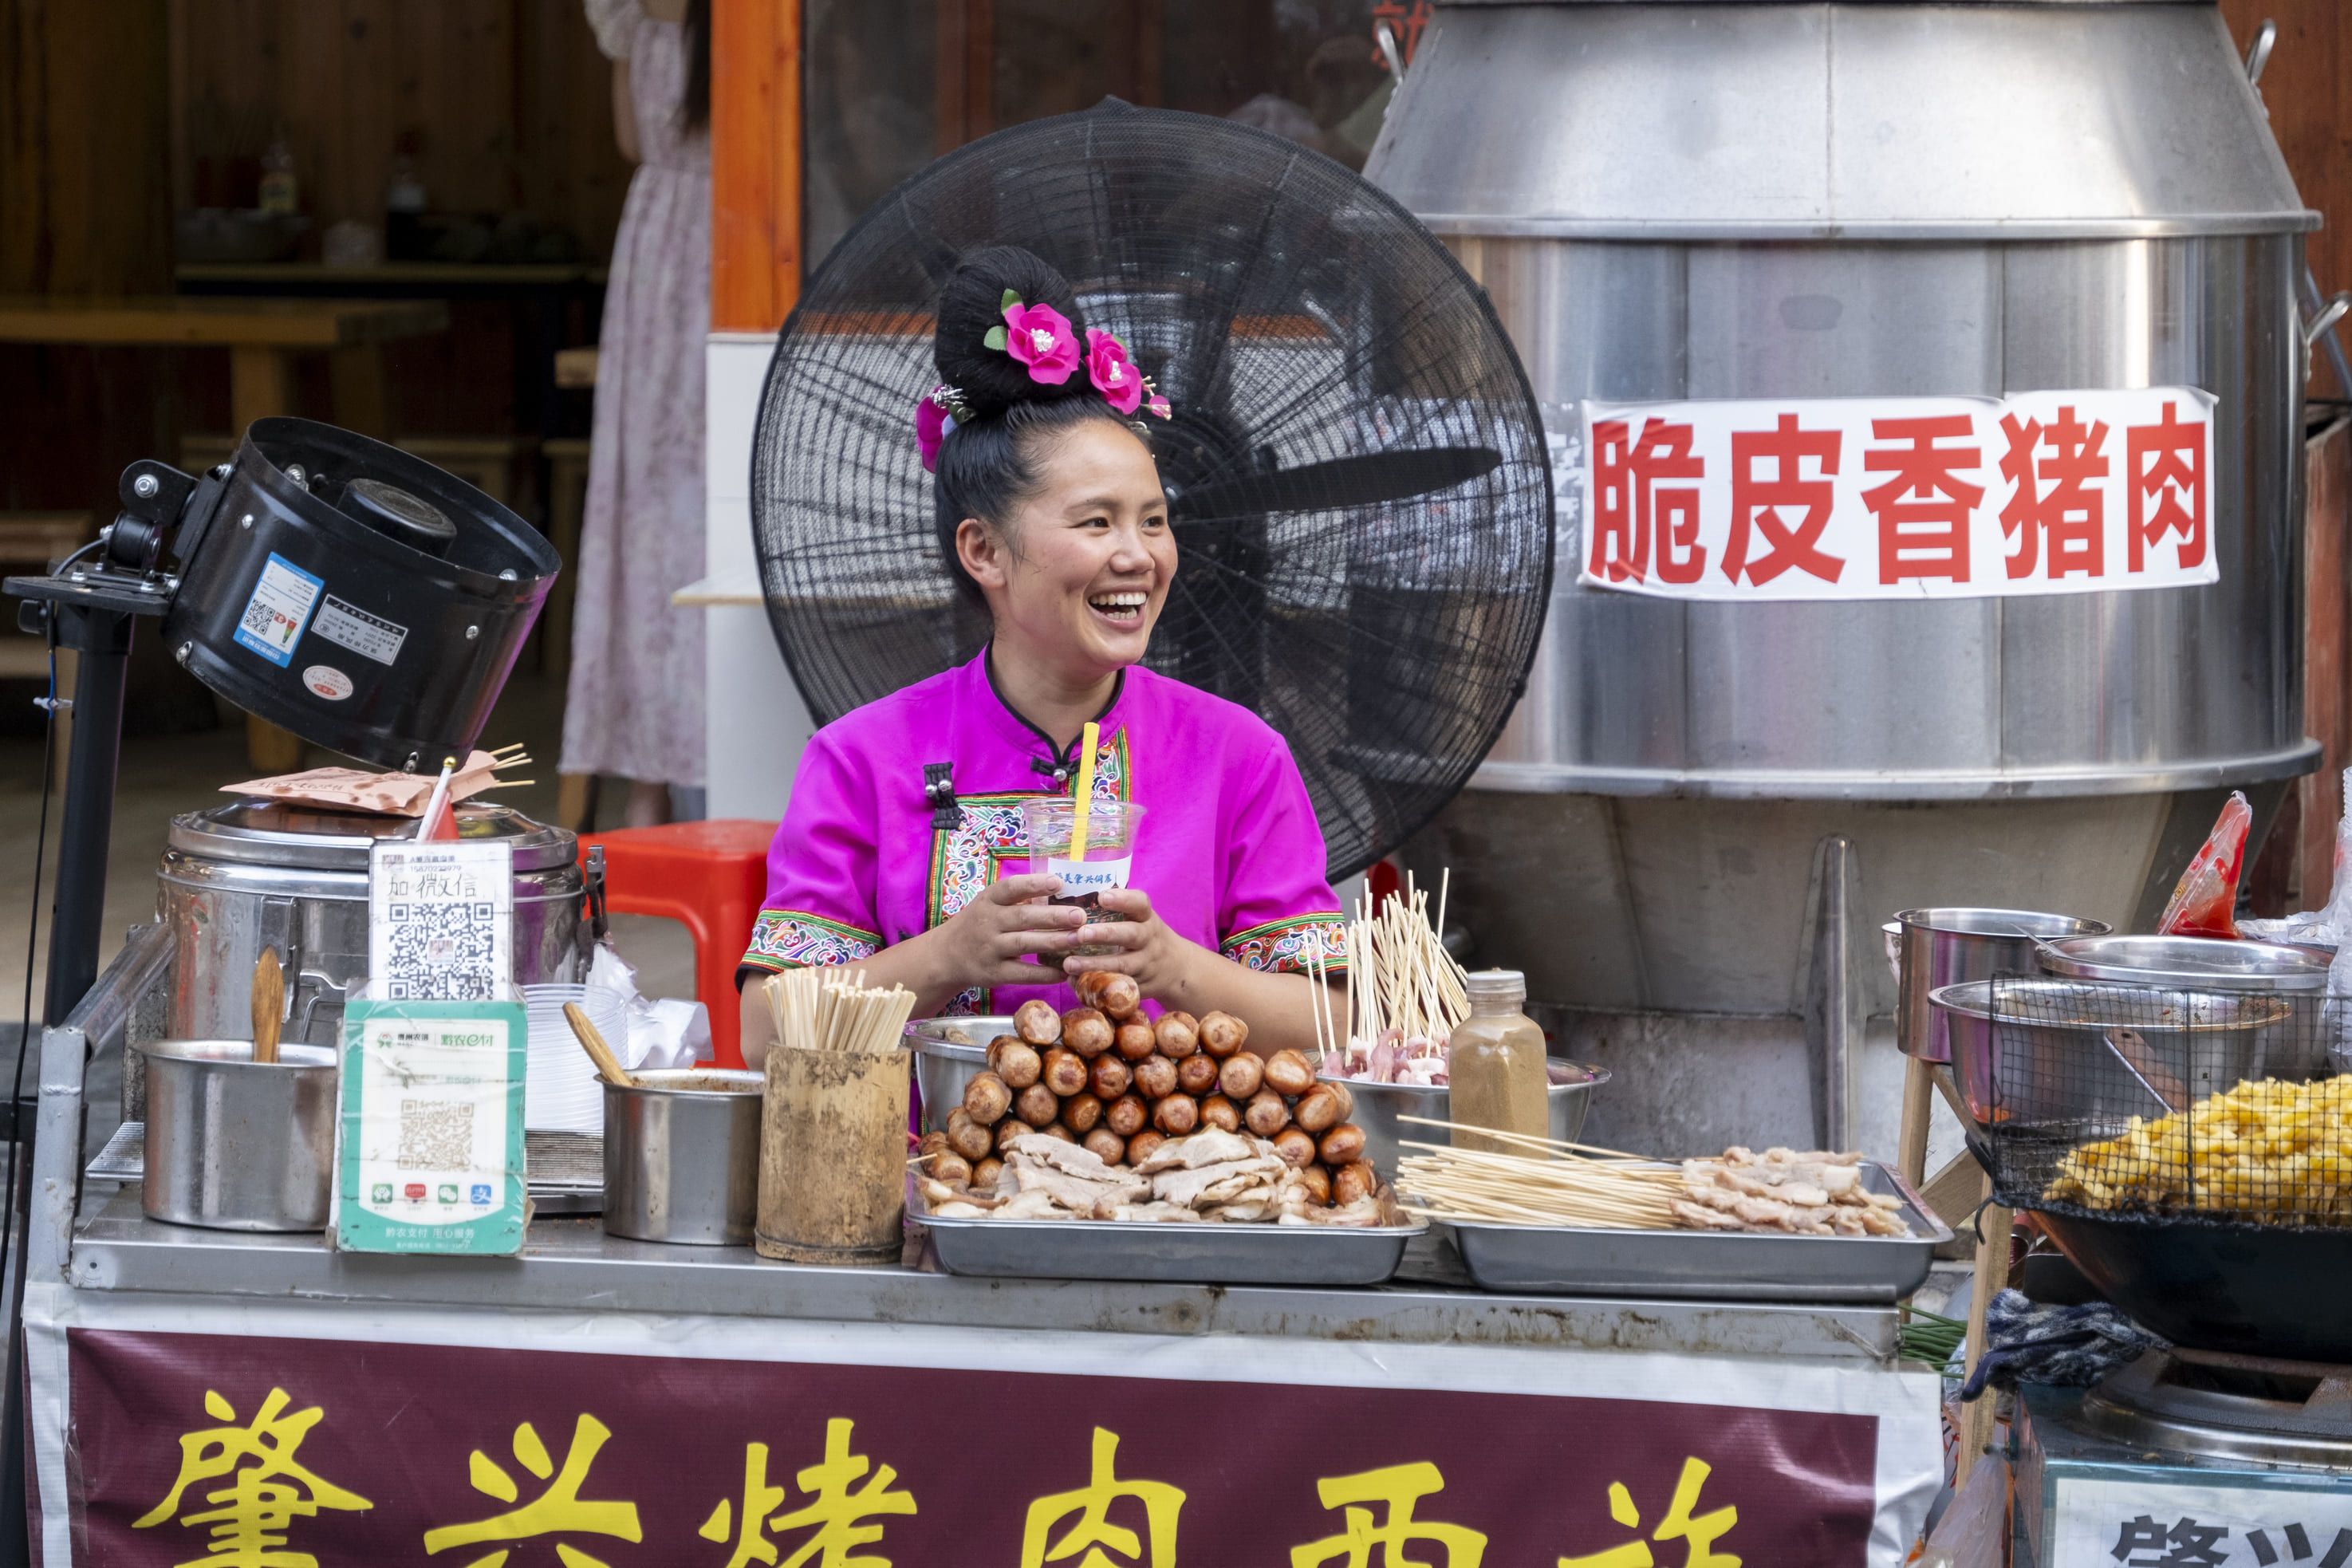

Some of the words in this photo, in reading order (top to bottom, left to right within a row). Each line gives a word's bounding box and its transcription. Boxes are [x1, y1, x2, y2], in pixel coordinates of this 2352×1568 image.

[1589, 401, 2207, 588] 脆皮香猪肉
